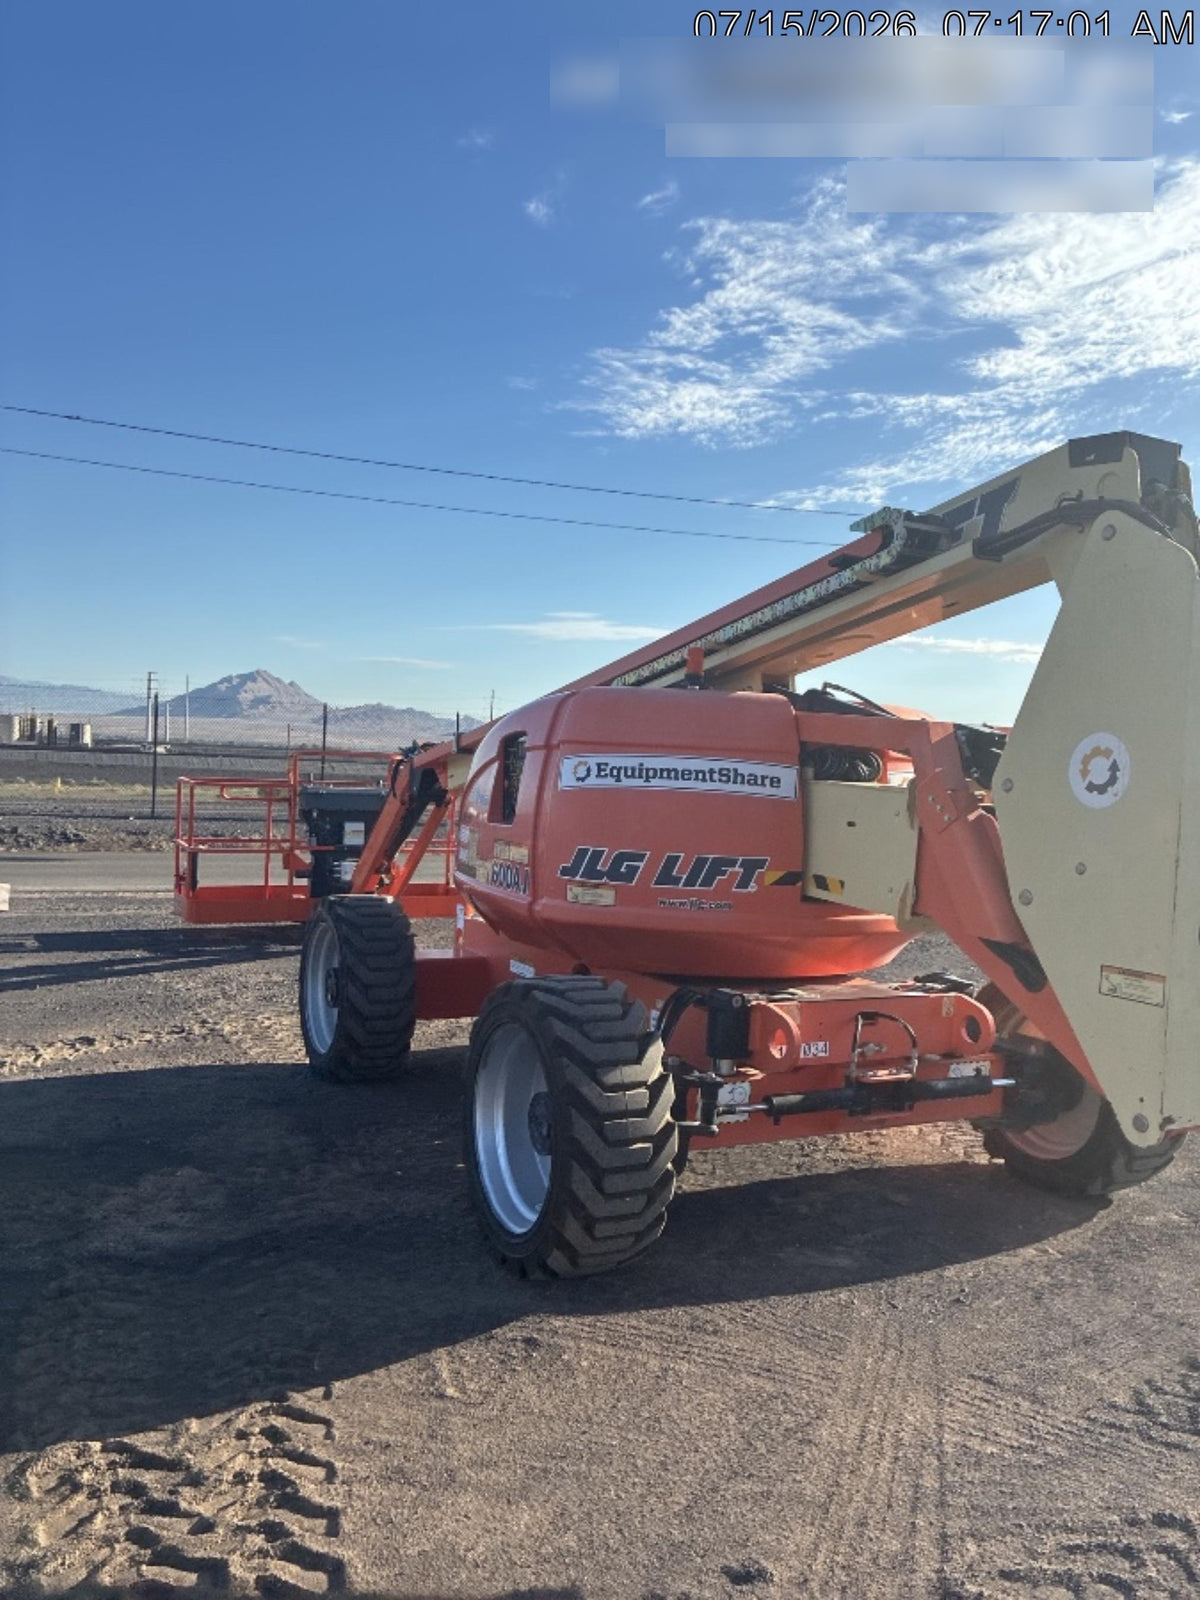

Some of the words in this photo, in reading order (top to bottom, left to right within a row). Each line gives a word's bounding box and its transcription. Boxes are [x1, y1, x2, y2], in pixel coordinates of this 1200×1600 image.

[594, 762, 782, 789] EquipmentShare
[557, 846, 650, 885] JLG
[651, 853, 770, 892] LIFT
